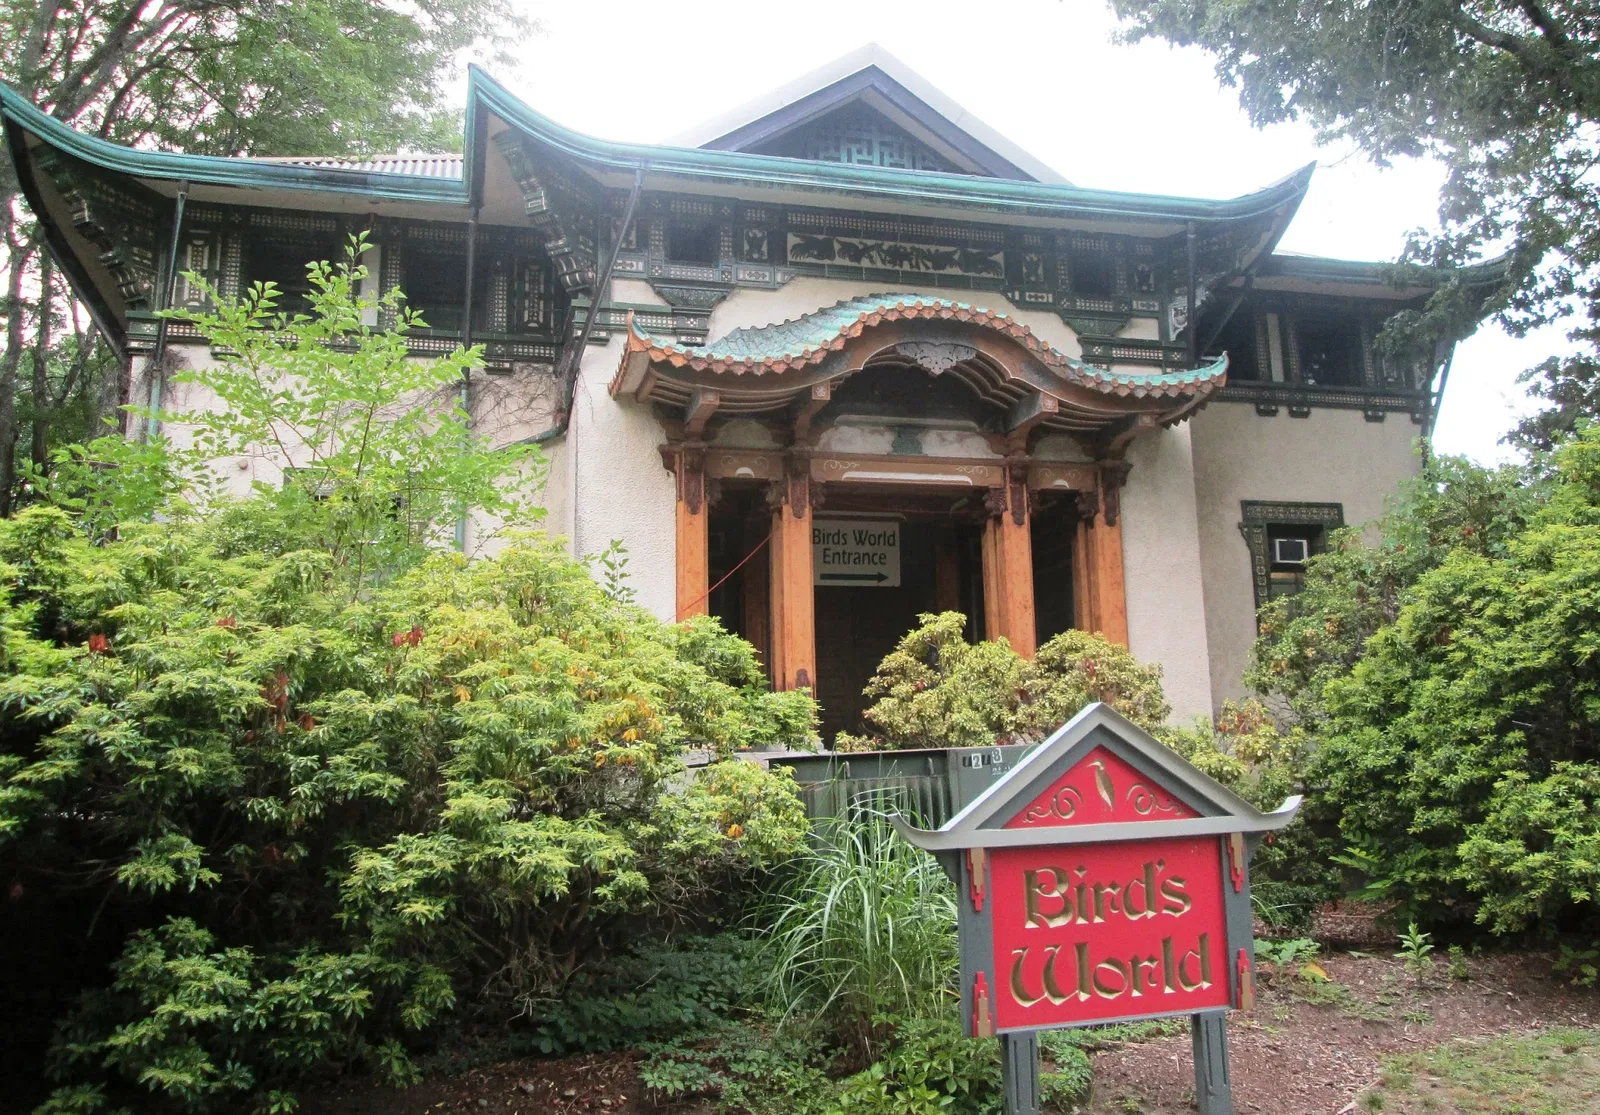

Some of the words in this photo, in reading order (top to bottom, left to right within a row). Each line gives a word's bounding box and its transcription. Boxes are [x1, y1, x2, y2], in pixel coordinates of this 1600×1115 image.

[812, 528, 847, 546] Birds
[853, 528, 896, 546] World
[822, 547, 887, 566] Entrance
[1024, 859, 1192, 929] Bird's
[1010, 932, 1213, 1008] World
